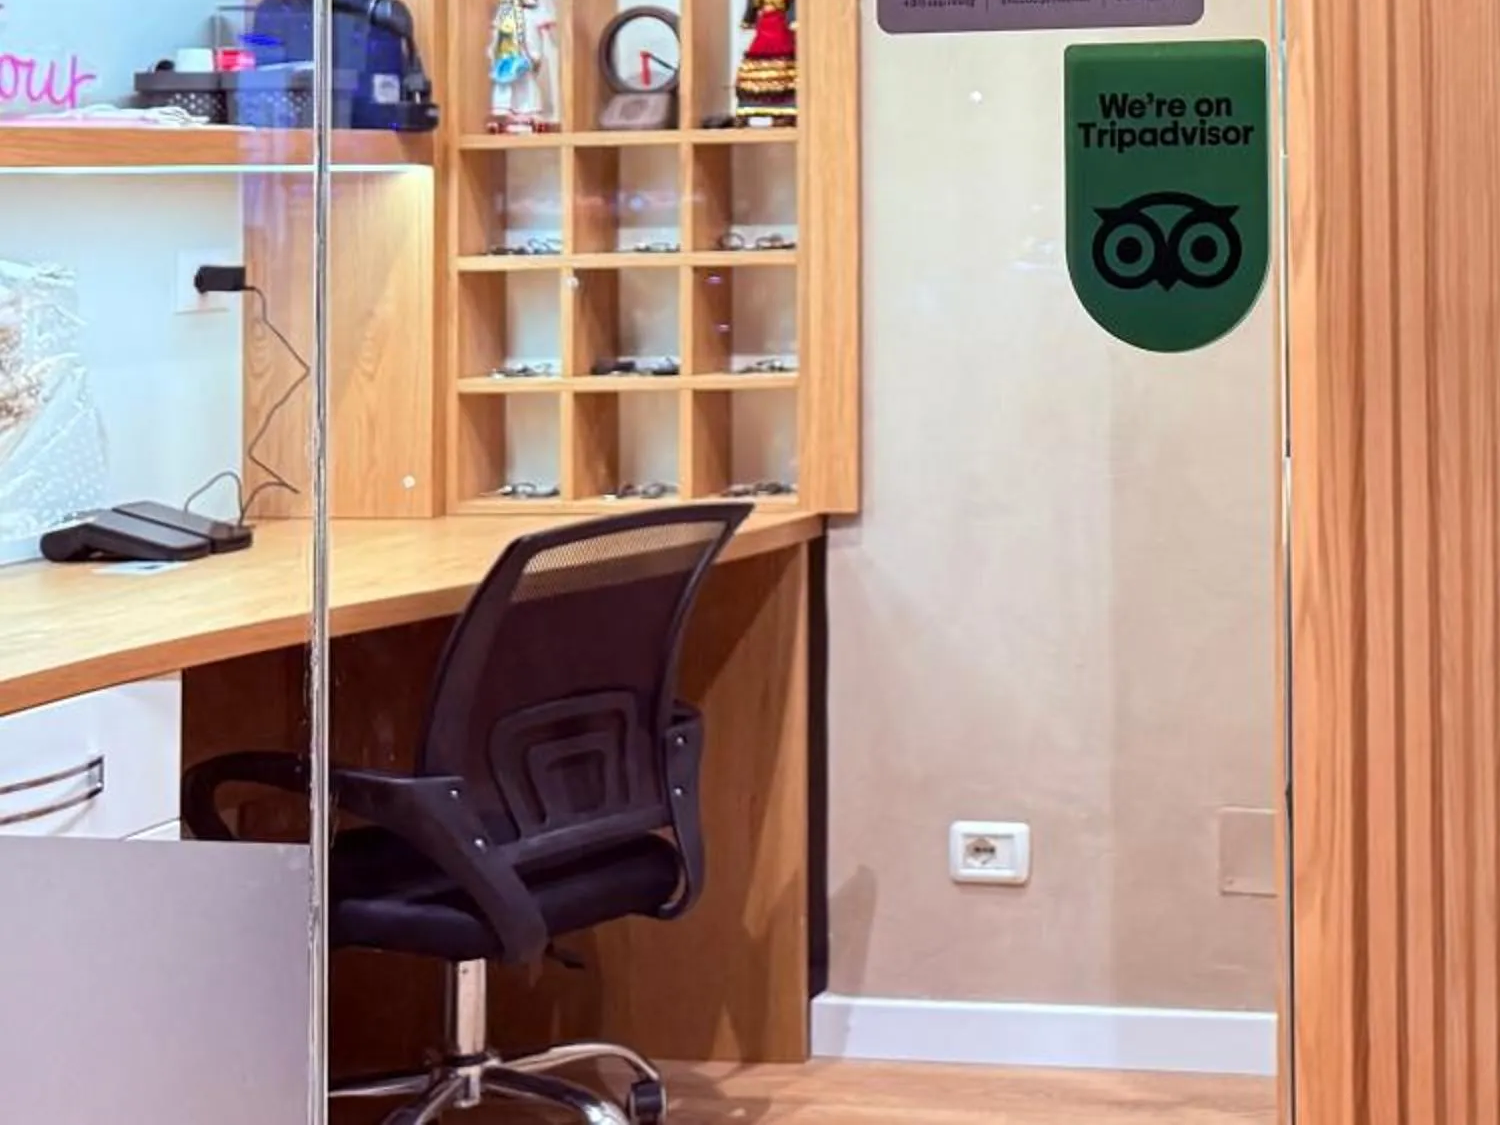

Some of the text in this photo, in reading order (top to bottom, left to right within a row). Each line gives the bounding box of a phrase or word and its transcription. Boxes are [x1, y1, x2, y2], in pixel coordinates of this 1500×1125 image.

[1098, 92, 1233, 120] We're on
[1077, 120, 1255, 154] Tripadvisor
